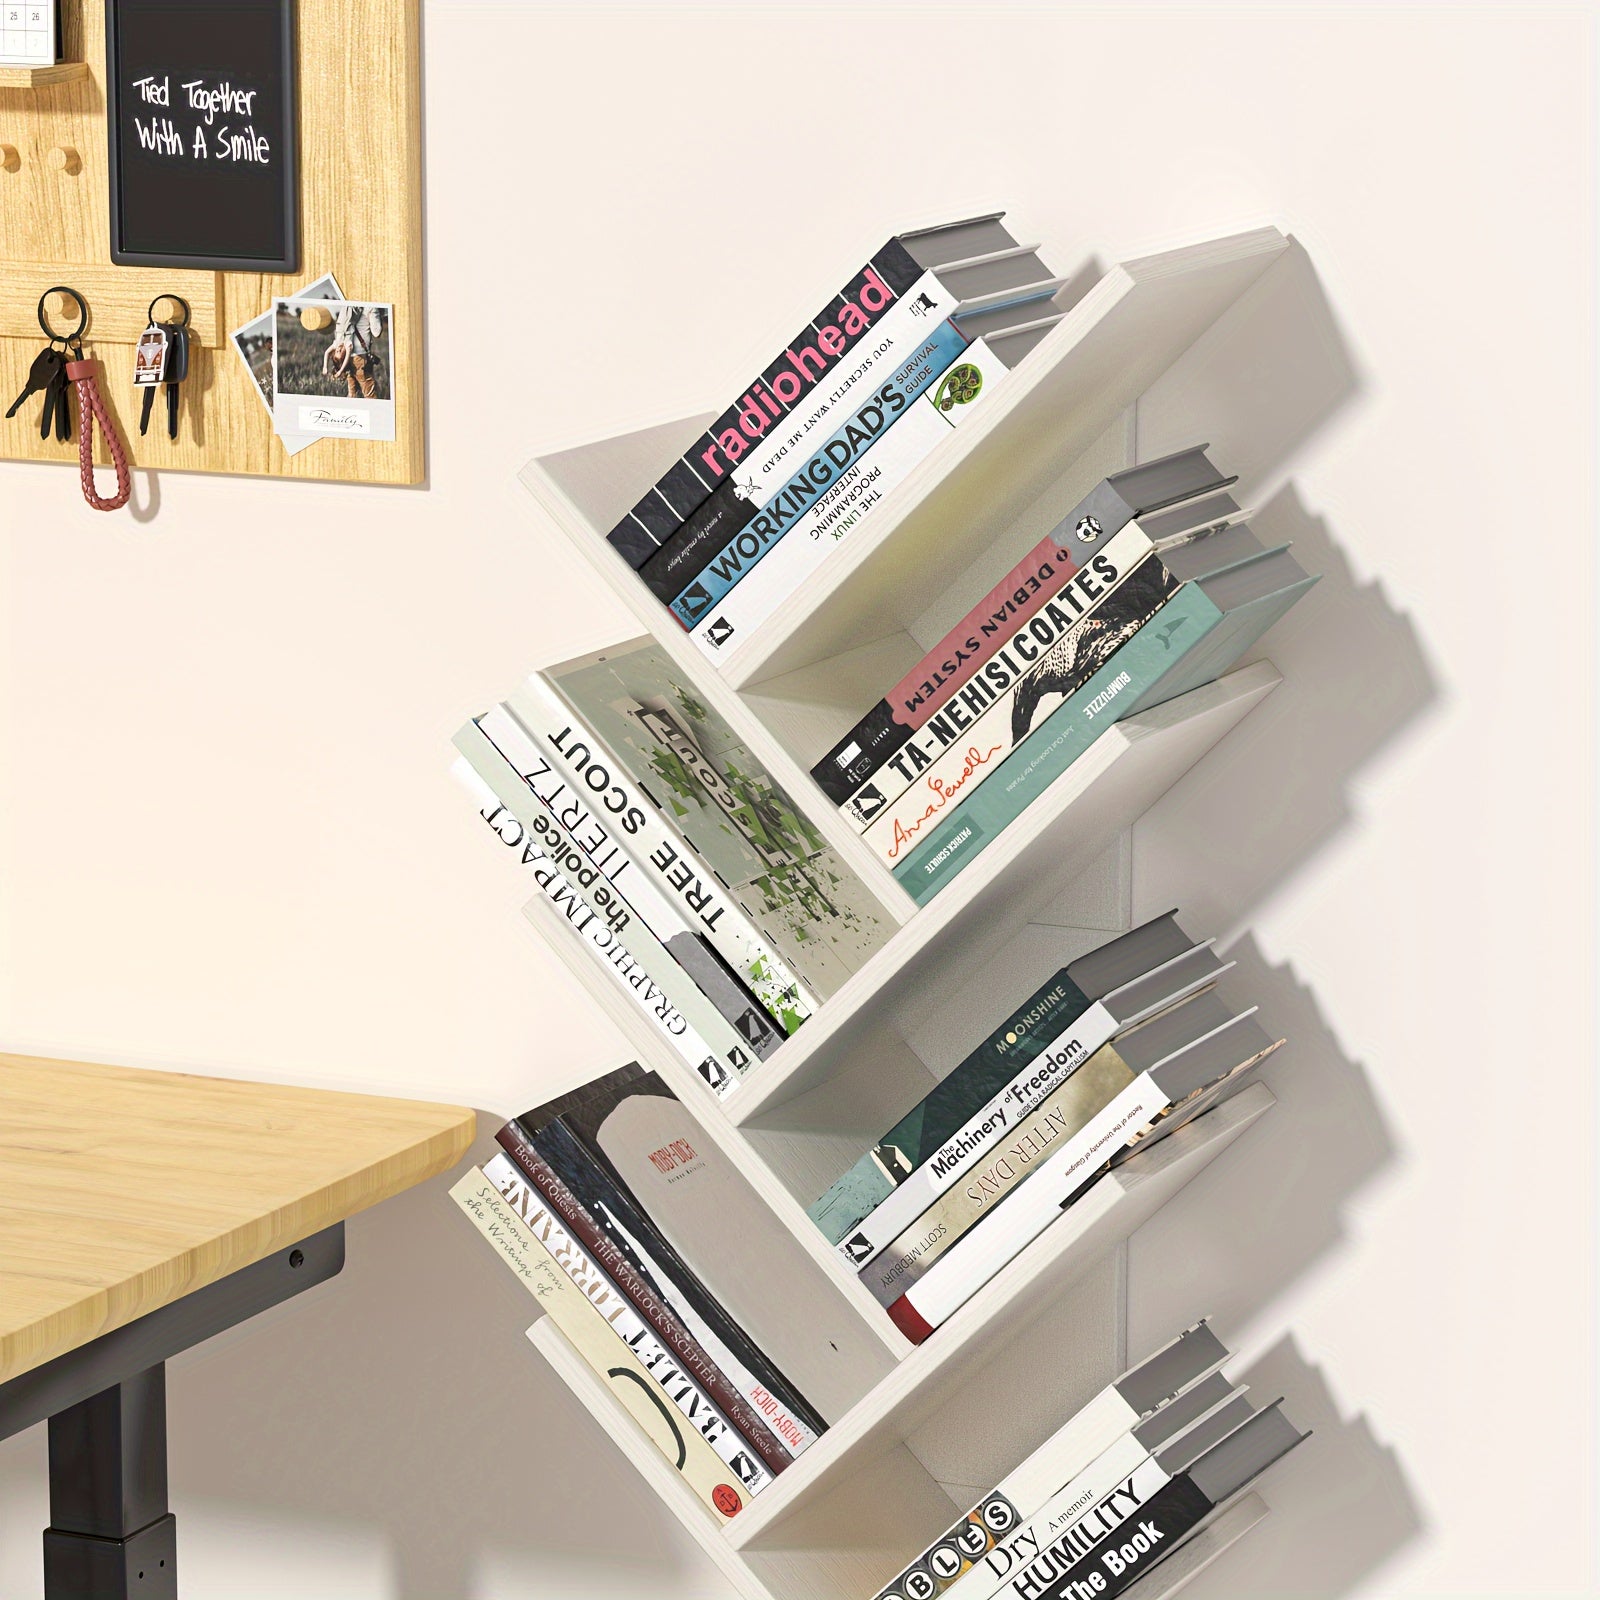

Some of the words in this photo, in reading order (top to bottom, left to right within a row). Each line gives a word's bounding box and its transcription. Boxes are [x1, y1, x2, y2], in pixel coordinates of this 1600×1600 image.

[10, 12, 18, 20] 25
[32, 12, 40, 20] 26
[133, 76, 169, 106] Tied
[182, 80, 257, 125] Together
[134, 118, 184, 156] With
[193, 126, 207, 159] A
[216, 126, 270, 164] Smile
[700, 268, 893, 476] radiohead
[874, 338, 894, 360] YOU
[896, 342, 938, 384] SURVIVAL
[830, 358, 873, 406] SECRETLY
[905, 365, 933, 394] GUIDE
[788, 431, 803, 447] ME
[806, 404, 830, 432] WANT
[709, 459, 832, 582] WORKING
[824, 384, 905, 470] DAD'S
[763, 446, 788, 473] DEAD
[810, 466, 881, 540] PROGRAMMING
[812, 466, 860, 517] INTERFACE
[859, 490, 882, 512] THE
[831, 510, 861, 540] LINUX
[981, 563, 1055, 638] DEBIAN
[888, 650, 1022, 783] TA-NEHISI
[1013, 555, 1118, 661] COATES
[904, 636, 981, 713] SYSTEM
[1083, 671, 1132, 720] BUMFUZZLE
[548, 726, 646, 835] SCOUT
[533, 814, 600, 889] police
[888, 804, 938, 857] Anna
[950, 827, 972, 853] PATRICK
[480, 801, 599, 935] IMPACT
[924, 848, 951, 874] SCHULTE
[594, 887, 631, 934] the
[650, 841, 726, 934] TREE
[593, 927, 687, 1036] GRAPHIC
[1005, 1090, 1013, 1103] of
[1011, 1039, 1082, 1104] Freedom
[1017, 1103, 1032, 1118] GUIDE
[1030, 1096, 1039, 1106] TO
[1038, 1093, 1044, 1101] A
[1041, 1075, 1062, 1097] RADICAL
[1061, 1050, 1089, 1077] CAPITALISM
[930, 1106, 1006, 1179] Machinery
[939, 1145, 955, 1158] The
[1010, 1105, 1068, 1164] AFTER
[1090, 1132, 1114, 1153] University
[1112, 1124, 1122, 1132] the
[515, 1144, 540, 1174] Book
[538, 1173, 552, 1186] of
[548, 1184, 577, 1220] Quests
[966, 1158, 1016, 1208] DAYS
[1065, 1157, 1085, 1177] Glasgow
[464, 1198, 485, 1220] the
[488, 1222, 532, 1279] Writings
[536, 1282, 553, 1297] of
[476, 1187, 529, 1252] Selections
[534, 1259, 565, 1291] from
[922, 1224, 947, 1252] SCOTT
[881, 1247, 922, 1288] MEDBURY
[594, 1240, 615, 1265] THE
[615, 1264, 672, 1334] WARLOCK'S
[671, 1331, 717, 1387] SCEPTER
[731, 1404, 750, 1429] Ryan
[750, 1428, 772, 1455] Steele
[883, 1506, 1008, 1600] BLES
[985, 1527, 1040, 1580] Dry
[1048, 1521, 1058, 1532] A
[1058, 1488, 1093, 1524] memoir
[1012, 1478, 1142, 1600] HUMILITY
[1059, 1570, 1107, 1600] The
[1101, 1518, 1165, 1576] Book
